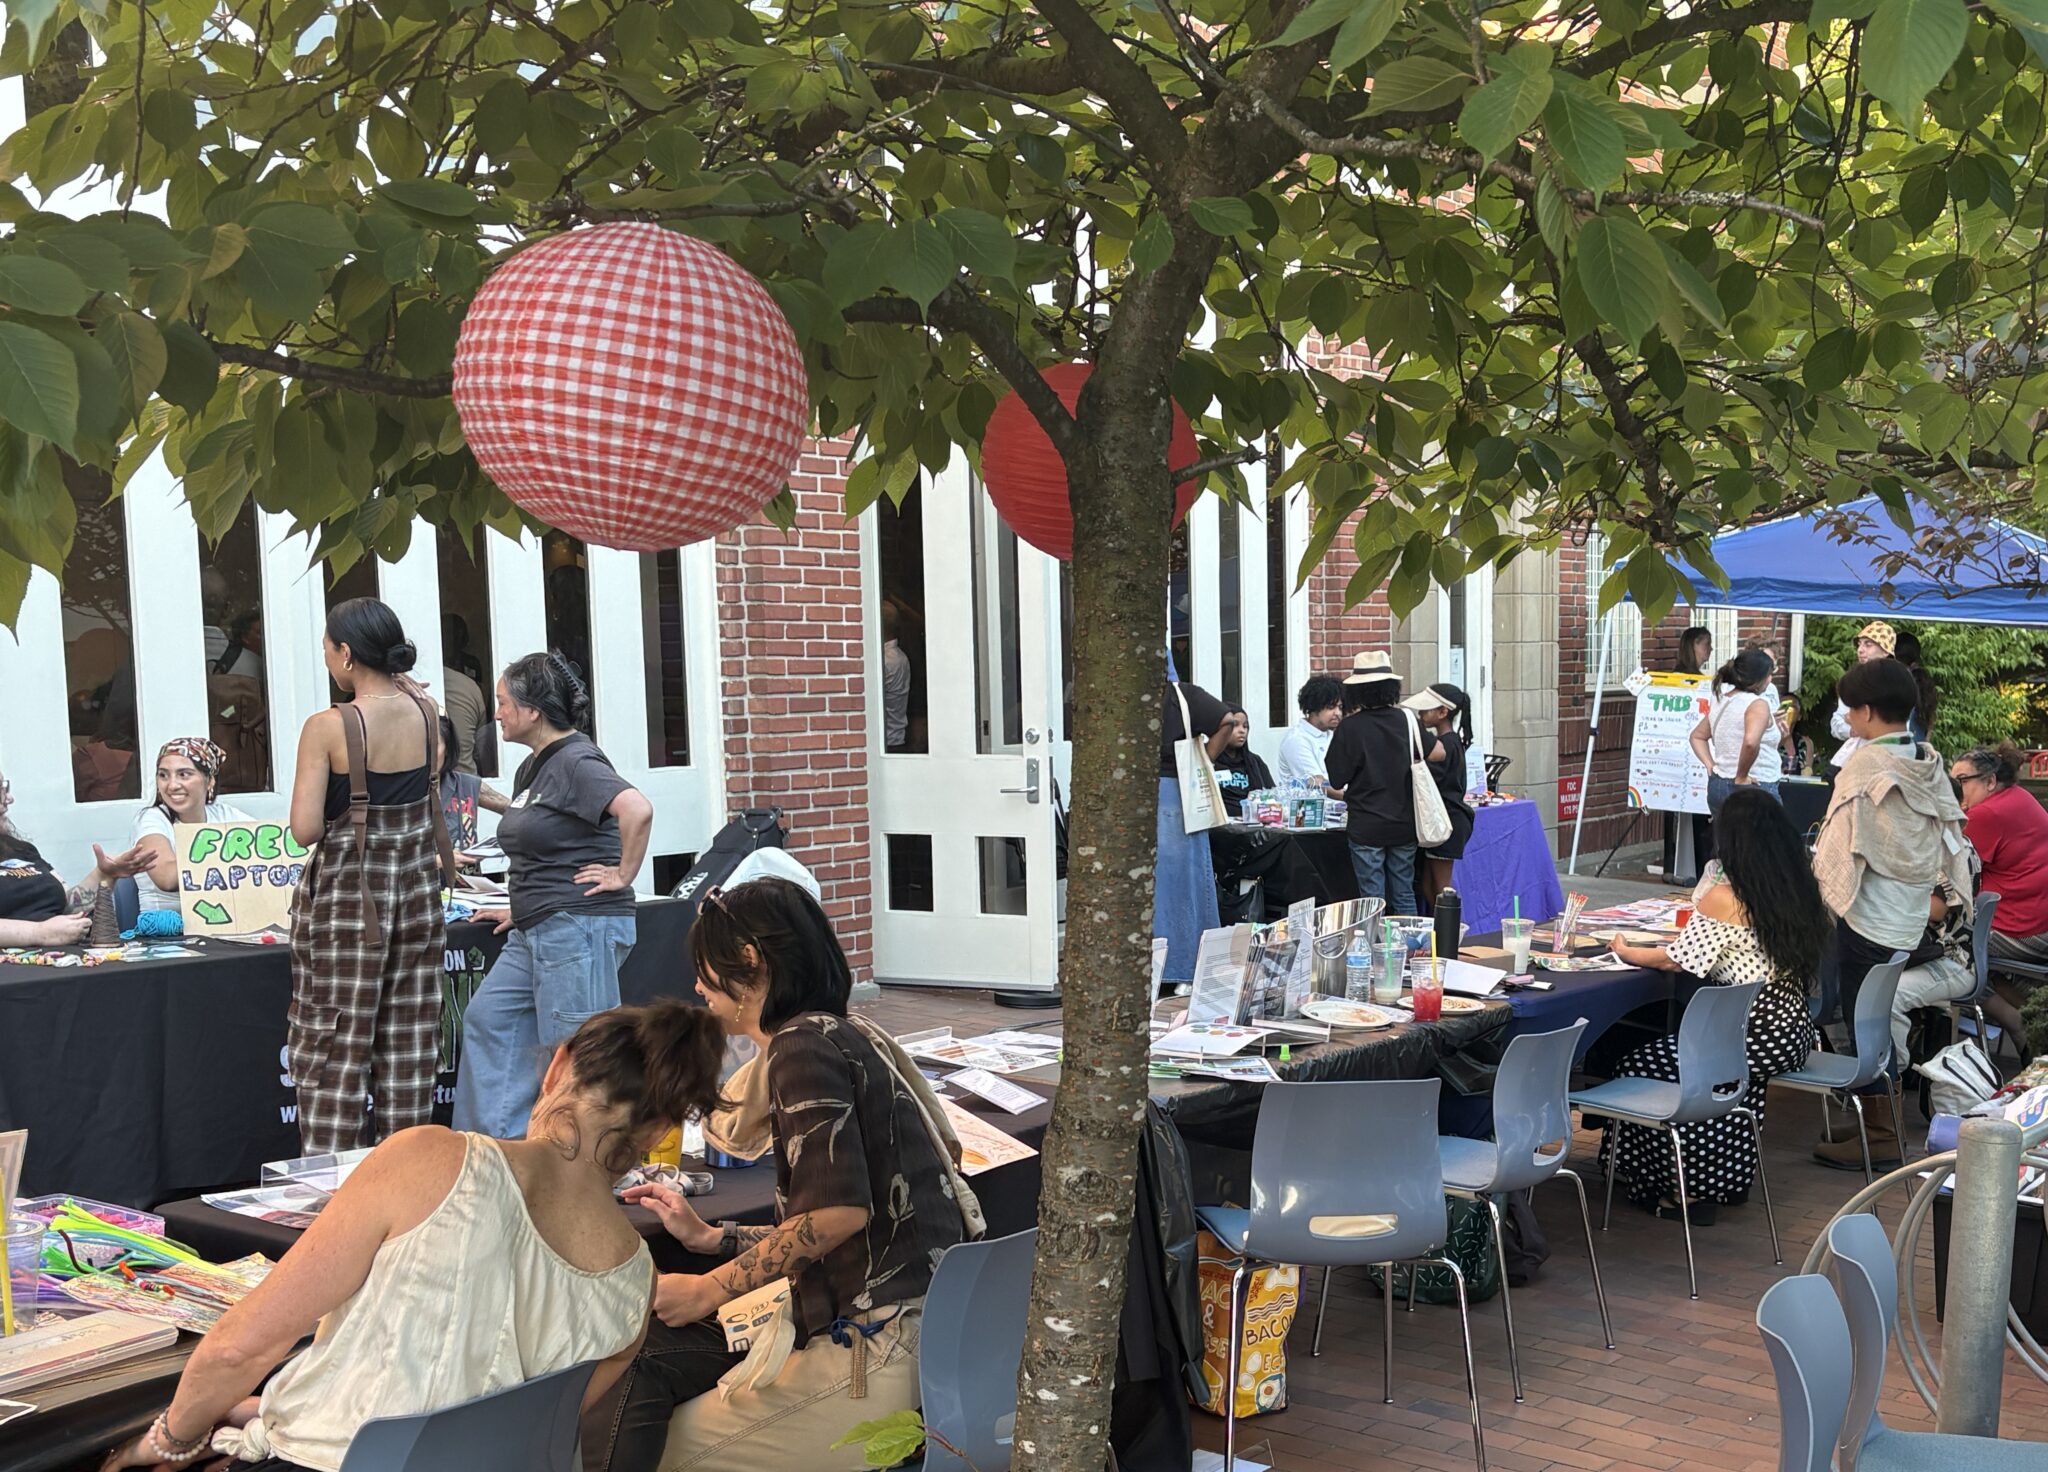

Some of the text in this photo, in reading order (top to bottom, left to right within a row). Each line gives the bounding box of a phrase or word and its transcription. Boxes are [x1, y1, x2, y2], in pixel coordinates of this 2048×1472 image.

[1647, 693, 1693, 712] THIS
[1560, 793, 1581, 804] MAXIMU
[1199, 1277, 1231, 1311] AC
